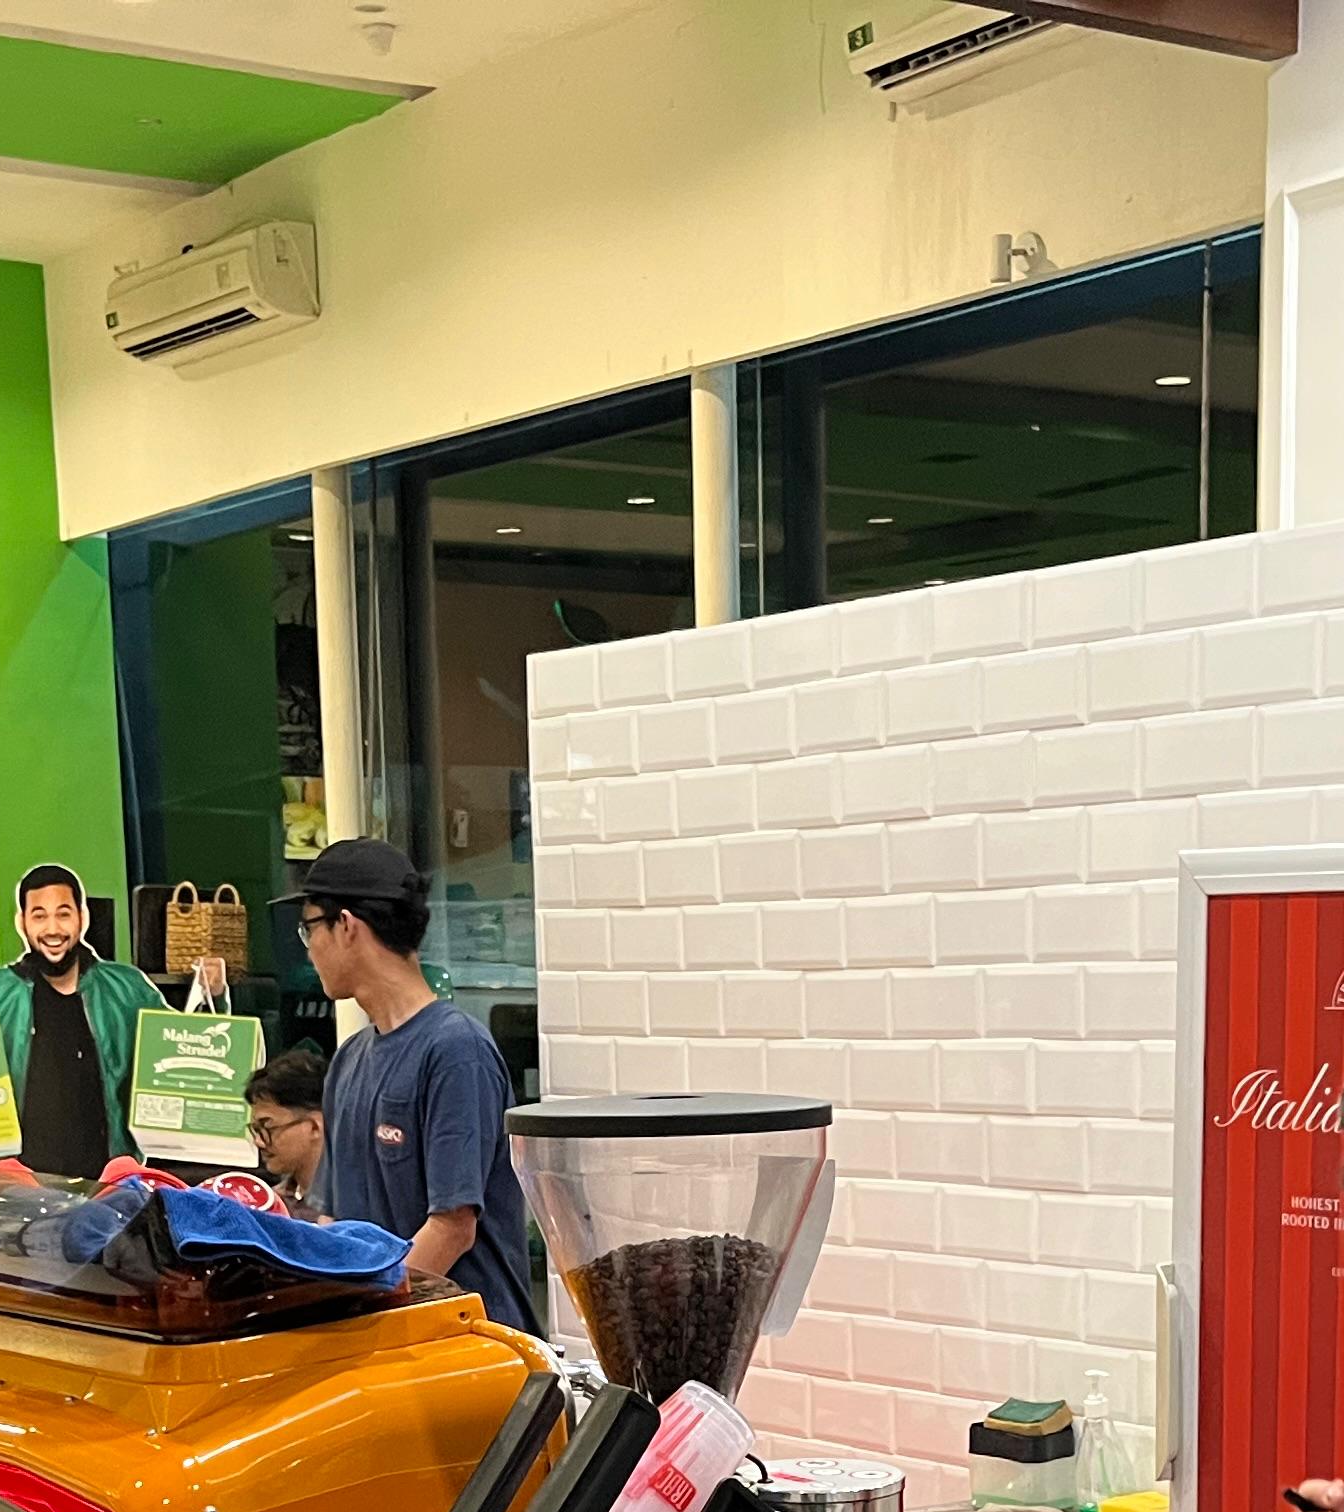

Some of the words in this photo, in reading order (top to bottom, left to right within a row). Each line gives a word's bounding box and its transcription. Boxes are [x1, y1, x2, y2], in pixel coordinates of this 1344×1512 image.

[162, 1028, 211, 1047] Malang
[177, 1042, 227, 1058] Strudel
[1281, 1213, 1330, 1230] ROOTED
